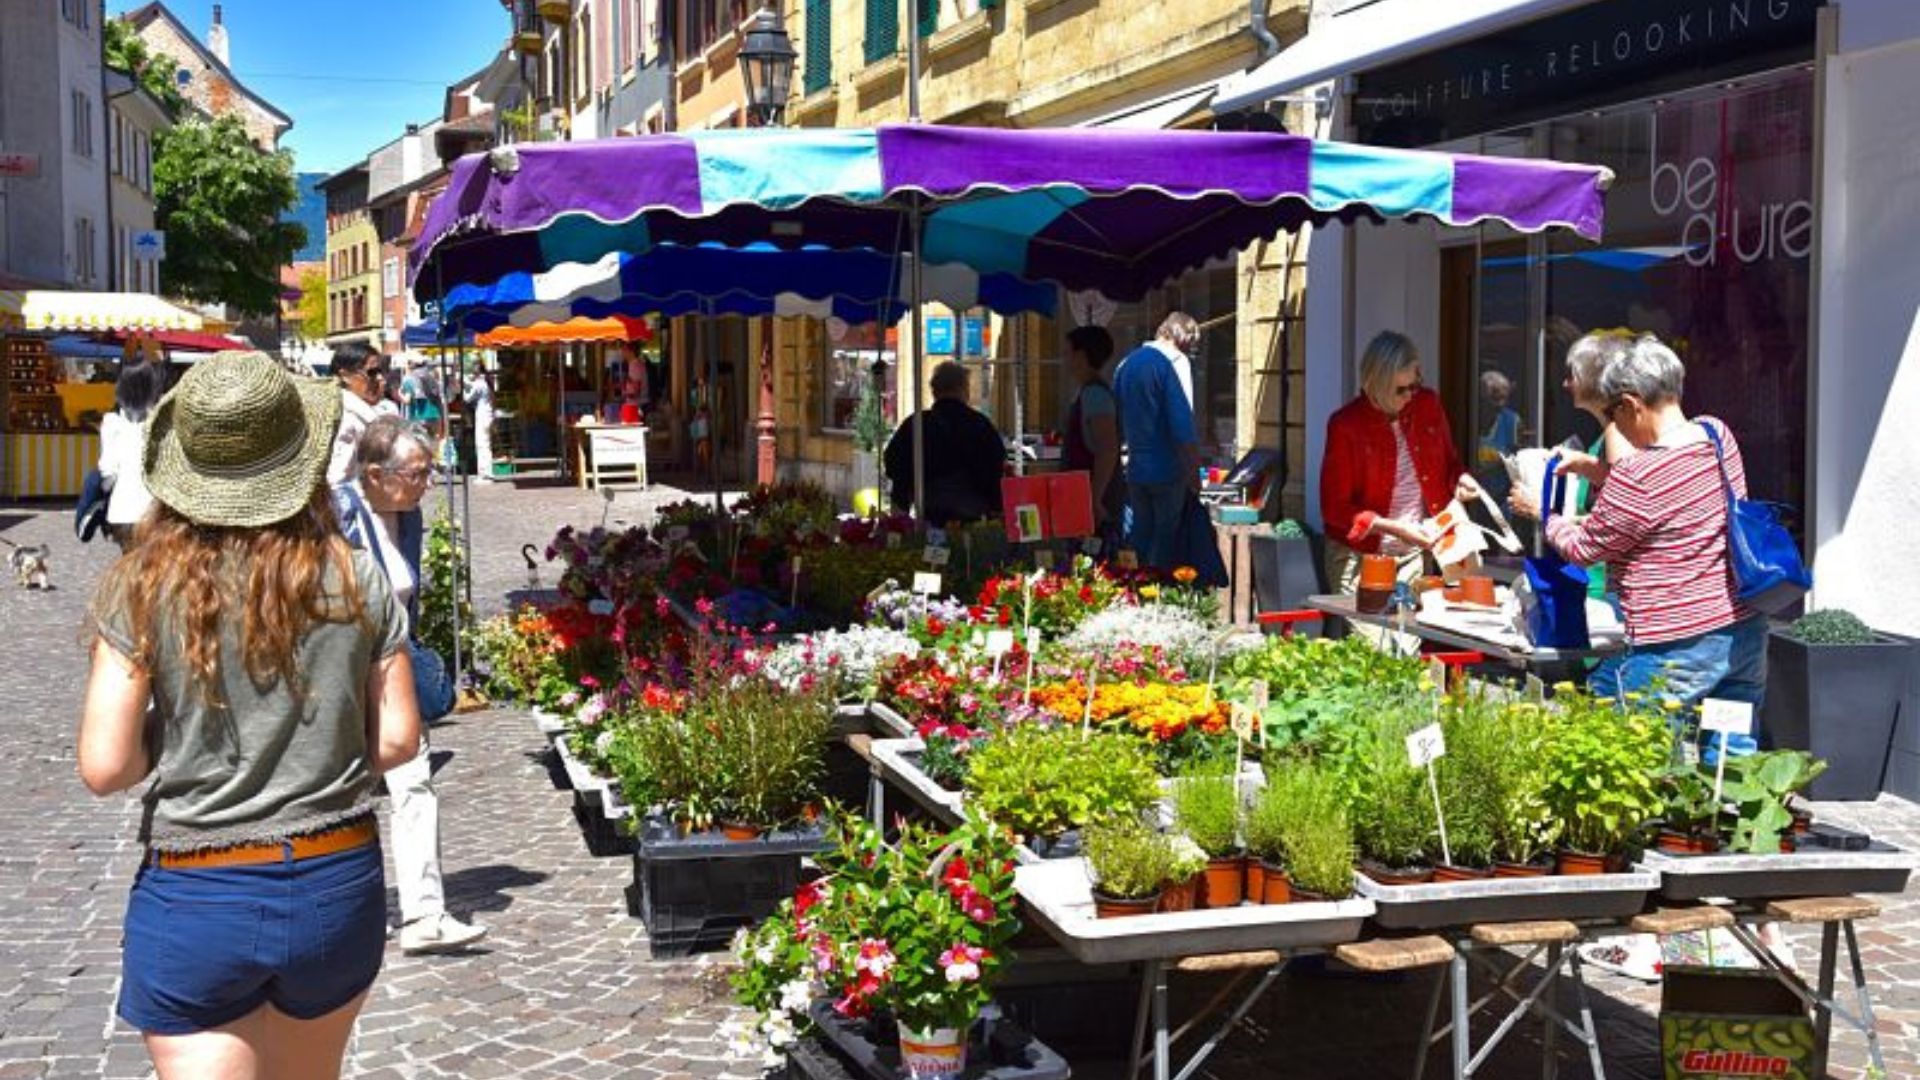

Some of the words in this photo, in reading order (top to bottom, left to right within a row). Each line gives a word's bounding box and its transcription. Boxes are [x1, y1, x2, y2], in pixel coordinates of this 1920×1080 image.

[1371, 63, 1512, 122] COIFFURE
[1546, 0, 1791, 77] RELOOKING
[1651, 112, 1717, 216] be
